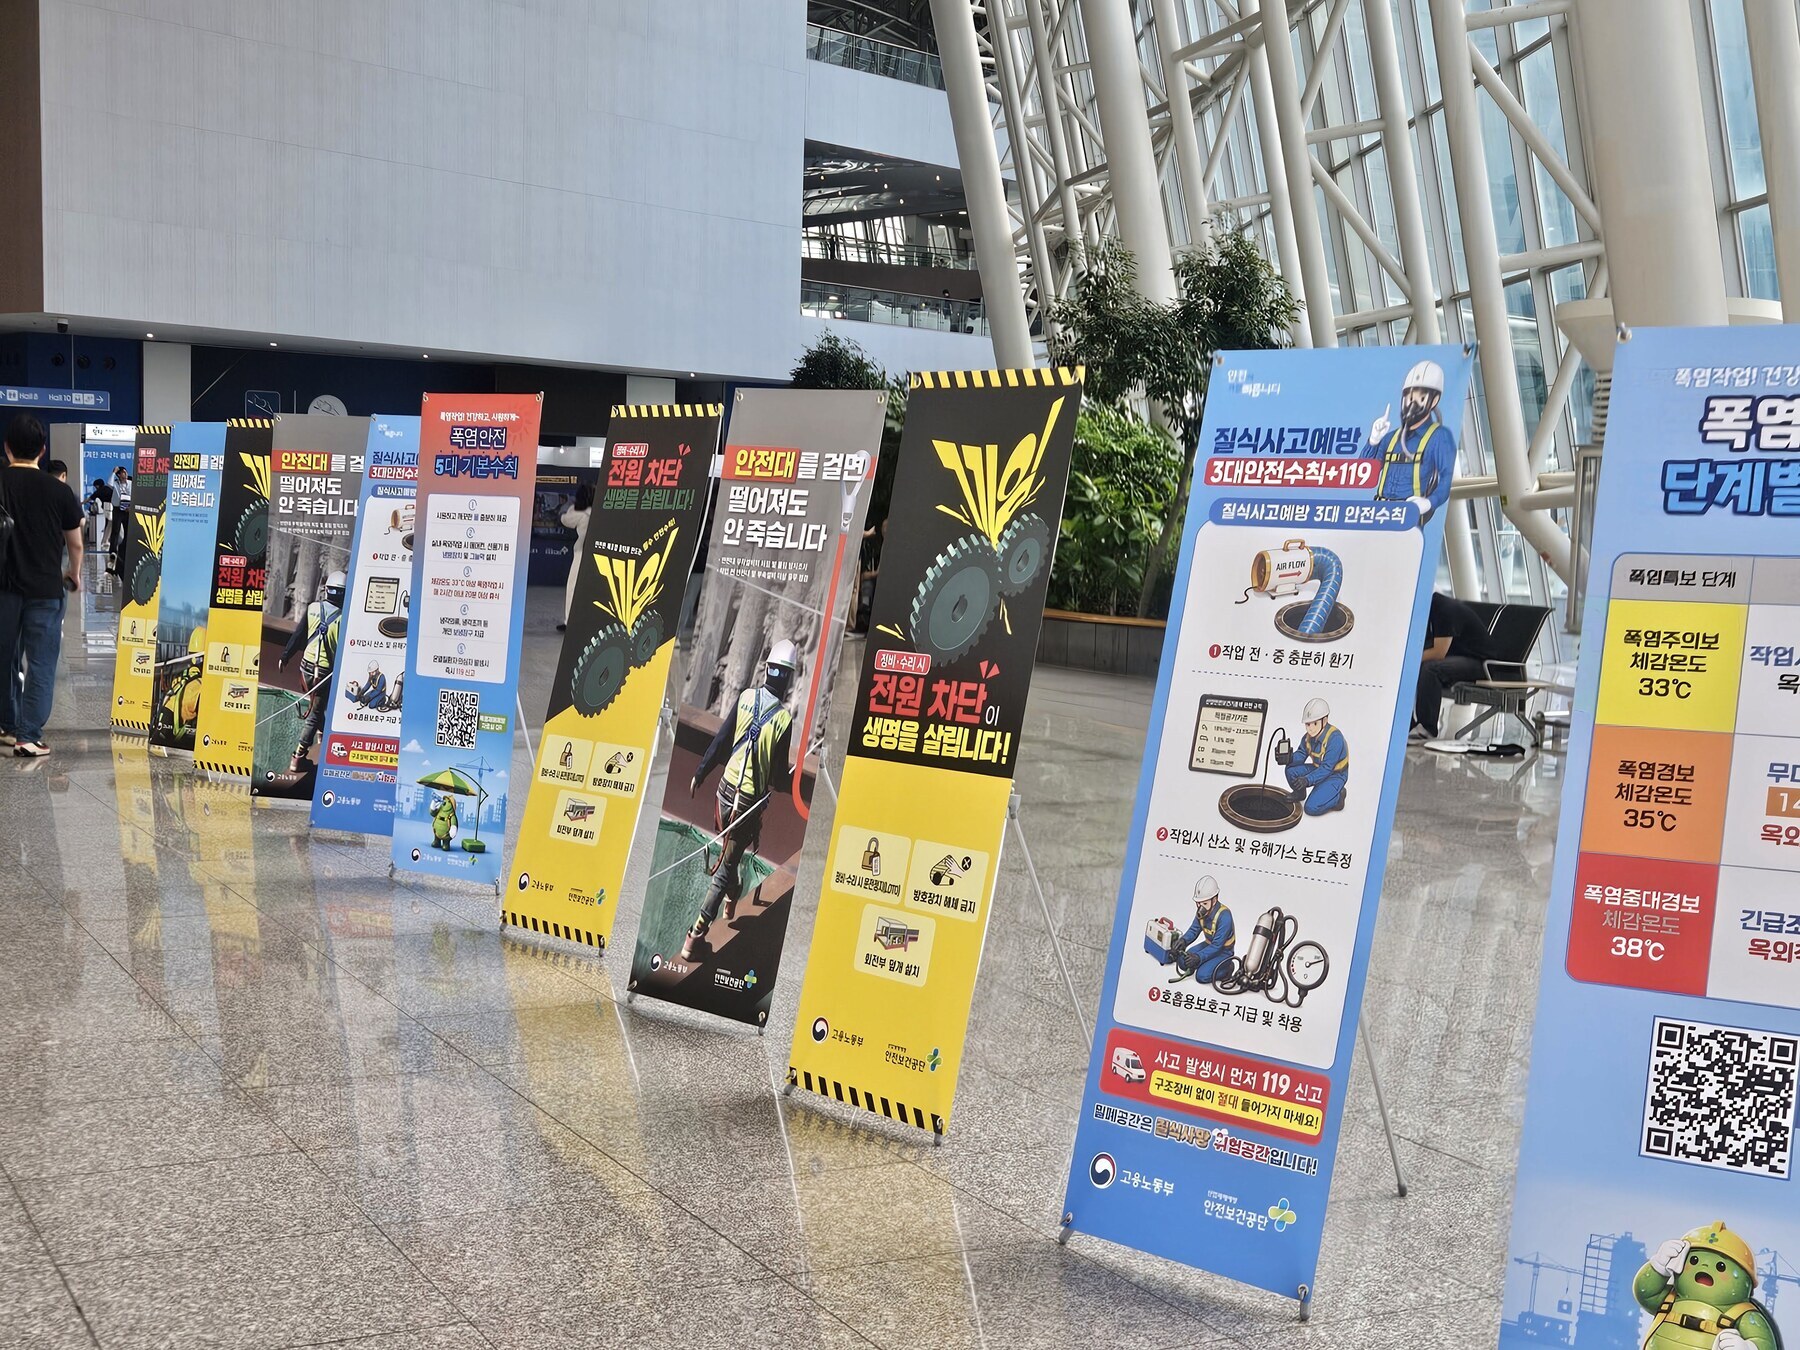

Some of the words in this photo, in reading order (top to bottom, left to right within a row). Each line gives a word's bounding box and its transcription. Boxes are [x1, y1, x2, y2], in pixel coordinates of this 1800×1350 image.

[1674, 366, 1758, 388] 폭염작업!
[1214, 426, 1362, 455] 질식사고예방
[281, 452, 346, 473] 안전대를
[372, 451, 419, 466] 질식사고
[434, 455, 459, 477] 5대
[461, 456, 519, 480] 기본수칙
[734, 449, 820, 480] 안전대를
[822, 452, 867, 482] 걸면
[172, 474, 206, 490] 떨어져도
[607, 459, 644, 487] 전원
[644, 459, 683, 487] 차단
[1210, 460, 1372, 486] 3대안전수칙+119
[280, 476, 342, 495] 떨어져도
[172, 492, 180, 506] 안
[181, 492, 215, 508] 죽습니다
[278, 496, 294, 514] 안
[296, 497, 359, 517] 죽습니다
[602, 488, 638, 510] 생명을
[640, 488, 696, 511] 살립니다!
[728, 486, 810, 517] 떨어져도
[1222, 502, 1310, 523] 질식사고예방
[1314, 505, 1340, 523] 3대
[1344, 505, 1407, 524] 안전수칙
[722, 518, 744, 546] 안
[746, 520, 828, 552] 죽습니다
[218, 567, 246, 588] 전원
[1276, 561, 1288, 572] AIR
[1288, 560, 1306, 571] FLOW
[1630, 568, 1697, 587] 폭염특보
[1701, 570, 1736, 588] 단계
[1624, 629, 1720, 651] 폭염주의보
[916, 657, 926, 672] 시
[1222, 645, 1246, 661] 작업
[1249, 646, 1261, 662] 전
[1272, 648, 1285, 665] 중
[1288, 650, 1325, 667] 충분히
[1329, 652, 1354, 670] 환기
[1630, 651, 1707, 673] 체감온도
[868, 673, 924, 717] 전원
[862, 716, 920, 754] 생명을
[922, 723, 1012, 765] 살립니다!
[1618, 760, 1696, 783] 폭염경보
[1614, 782, 1693, 806] 체감온도
[1169, 828, 1204, 848] 작업시
[1208, 834, 1230, 850] 산소
[1234, 838, 1246, 854] 및
[1250, 840, 1298, 860] 유해가스
[1301, 847, 1352, 870] 농도측정
[913, 890, 943, 907] 방호장치
[960, 899, 976, 914] 금지
[1584, 884, 1700, 914] 폭염중대경보
[1602, 909, 1680, 936] 체감온도
[864, 952, 887, 970] 회전부
[904, 963, 920, 978] 설치
[1160, 990, 1231, 1017] 호흡용보호구
[1234, 1004, 1258, 1024] 지급
[1262, 1010, 1274, 1027] 및
[1278, 1013, 1303, 1034] 착용
[832, 1028, 864, 1047] 고용노동부
[885, 1050, 926, 1072] 안전보건공단
[1154, 1050, 1180, 1071] 사고
[1186, 1057, 1226, 1082] 발생시
[1230, 1067, 1258, 1090] 먼저
[1262, 1071, 1291, 1096] 119
[1294, 1081, 1324, 1104] 신고
[1154, 1078, 1192, 1098] 구조장비
[1195, 1086, 1216, 1104] 없이
[1218, 1091, 1240, 1110] 절대
[1241, 1098, 1282, 1120] 들어가지
[1284, 1108, 1320, 1130] 마세요!
[1094, 1104, 1154, 1132] 밀폐공간은
[1212, 1131, 1318, 1176] 위험공간입니다!
[1120, 1170, 1175, 1196] 고용노동부
[1204, 1200, 1268, 1232] 안전보건공단
